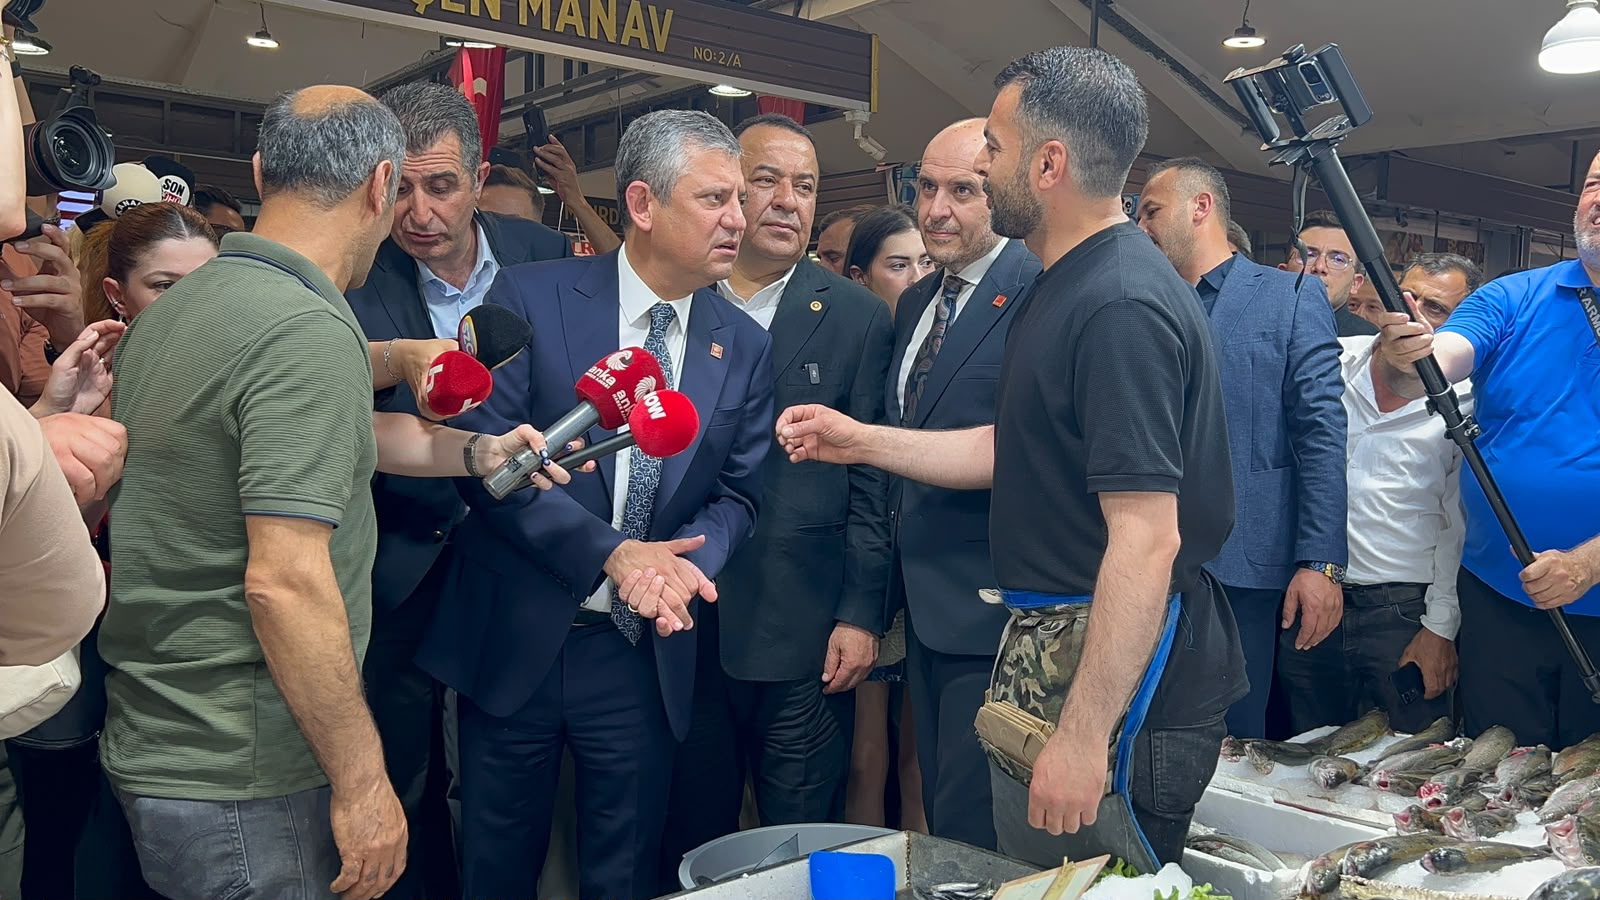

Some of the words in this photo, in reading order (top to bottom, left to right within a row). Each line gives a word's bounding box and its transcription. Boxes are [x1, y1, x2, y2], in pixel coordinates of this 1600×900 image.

[519, 0, 674, 52] MANAV
[693, 46, 742, 68] NO:2/A
[163, 178, 185, 197] SON
[588, 366, 616, 387] anka
[616, 389, 636, 415] ank
